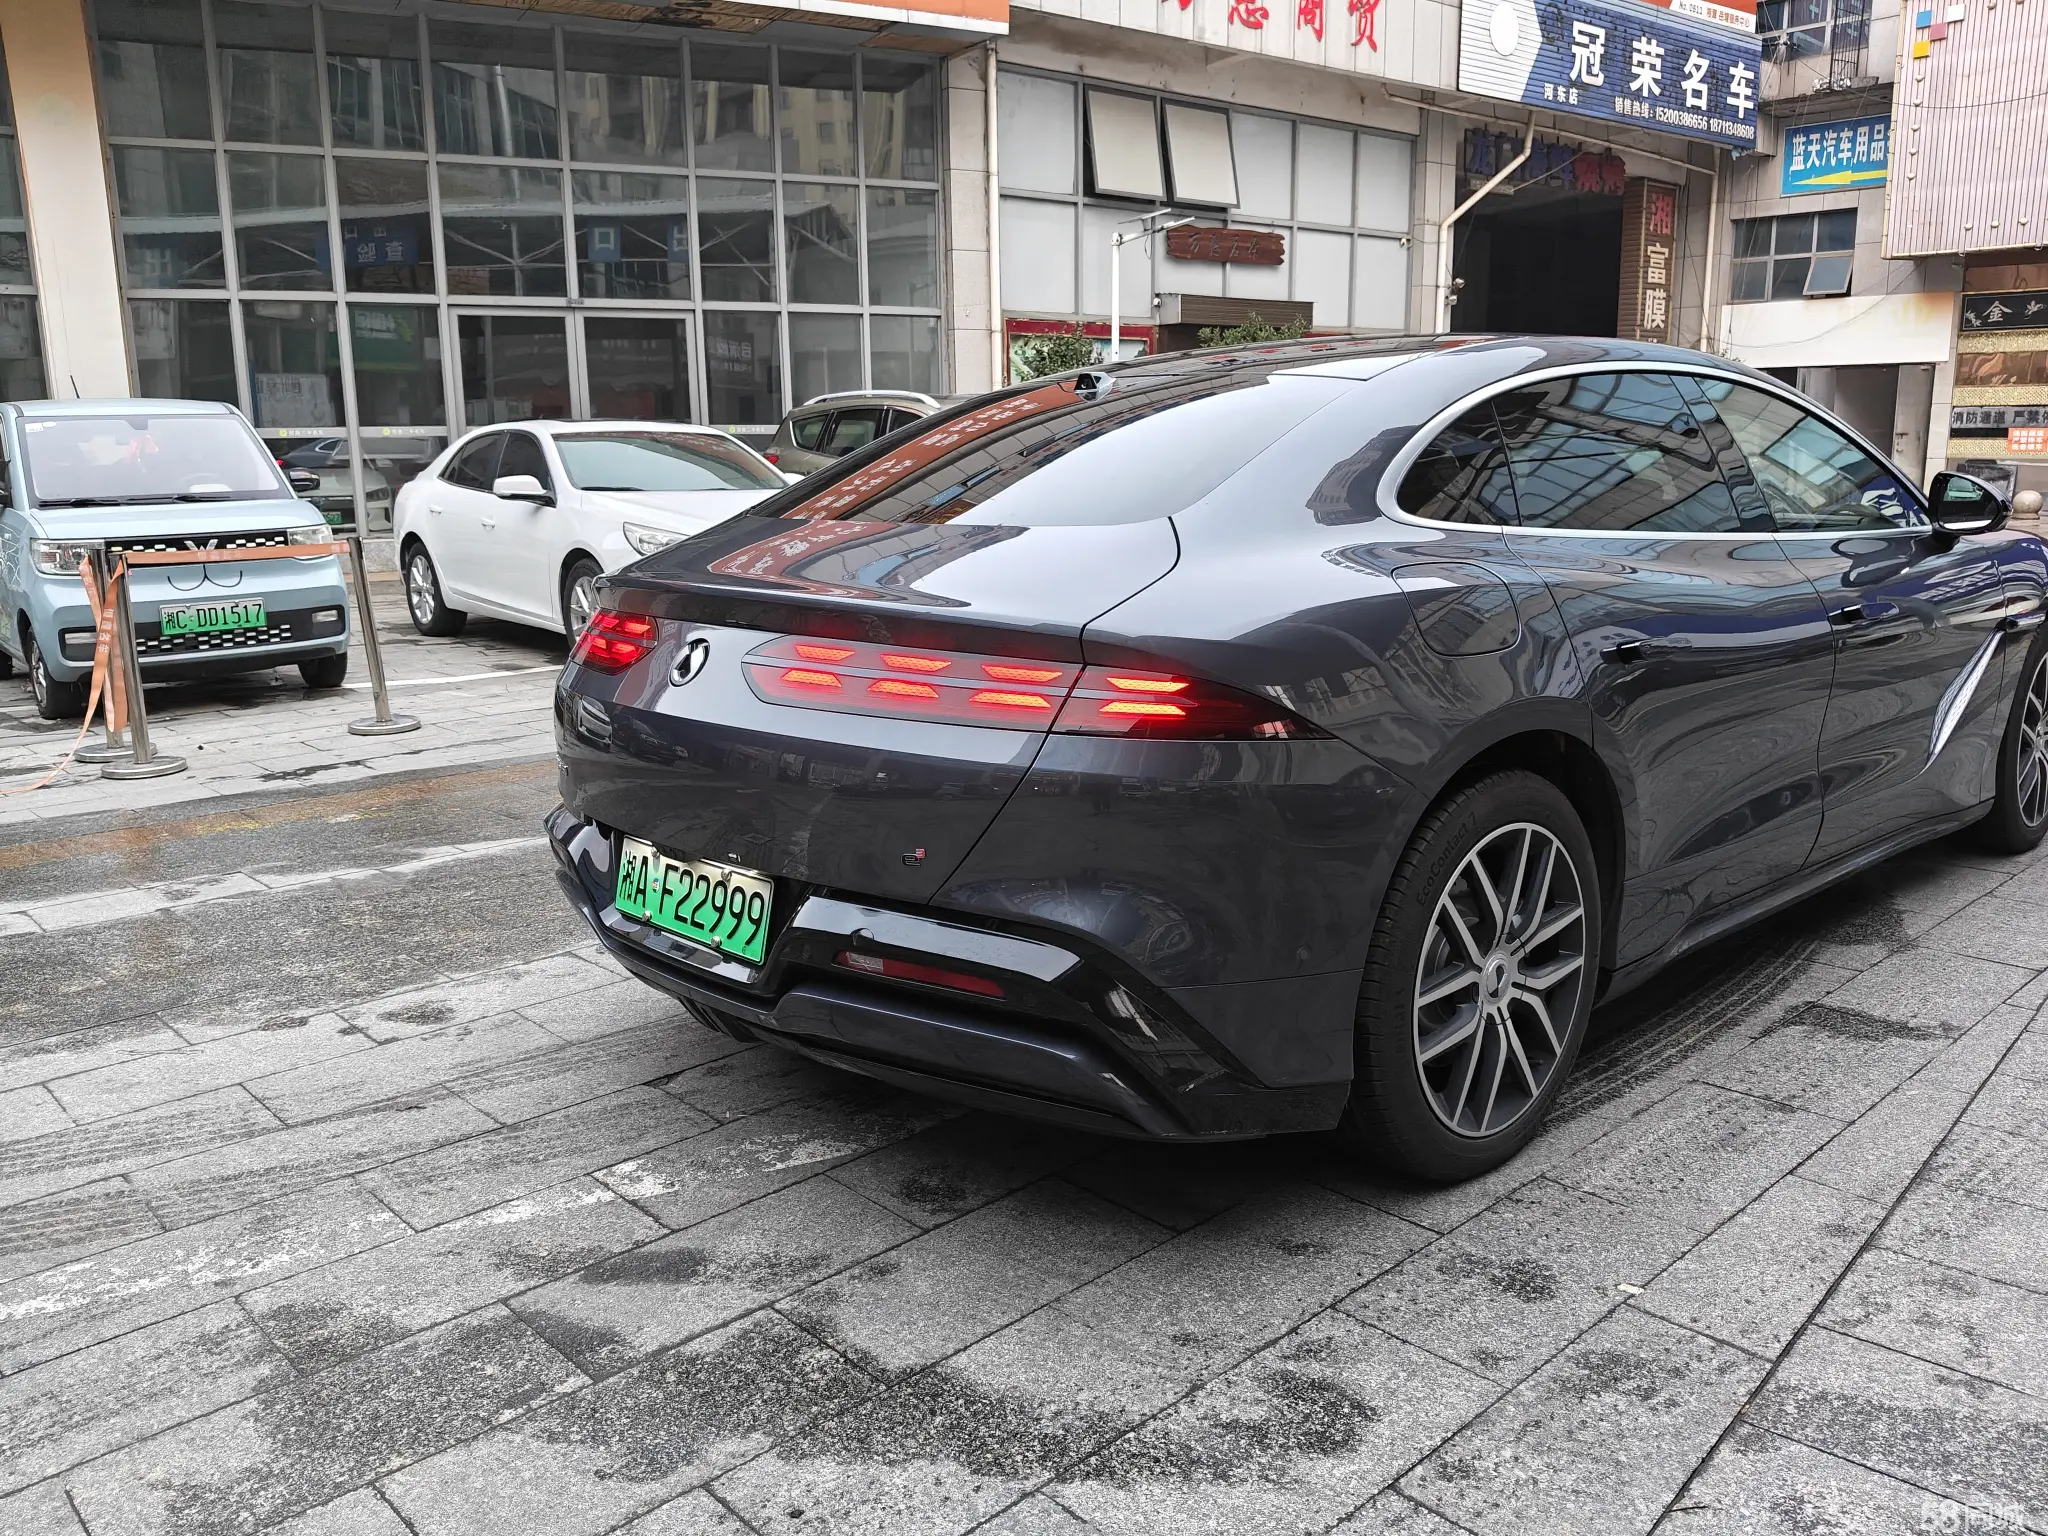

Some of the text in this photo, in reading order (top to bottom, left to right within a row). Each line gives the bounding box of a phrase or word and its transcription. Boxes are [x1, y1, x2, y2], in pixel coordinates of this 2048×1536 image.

[1569, 20, 1755, 119] 冠荣名车
[1544, 82, 1579, 106] 河东店
[1655, 106, 1708, 131] 15200386656
[1710, 119, 1755, 140] 18711348608
[1791, 123, 1890, 171] 蓝天汽车用品
[1644, 193, 1673, 343] 湘富膜
[1982, 300, 2013, 323] 金
[1952, 410, 2006, 426] 消防通道
[1417, 822, 1469, 906] EcoContact
